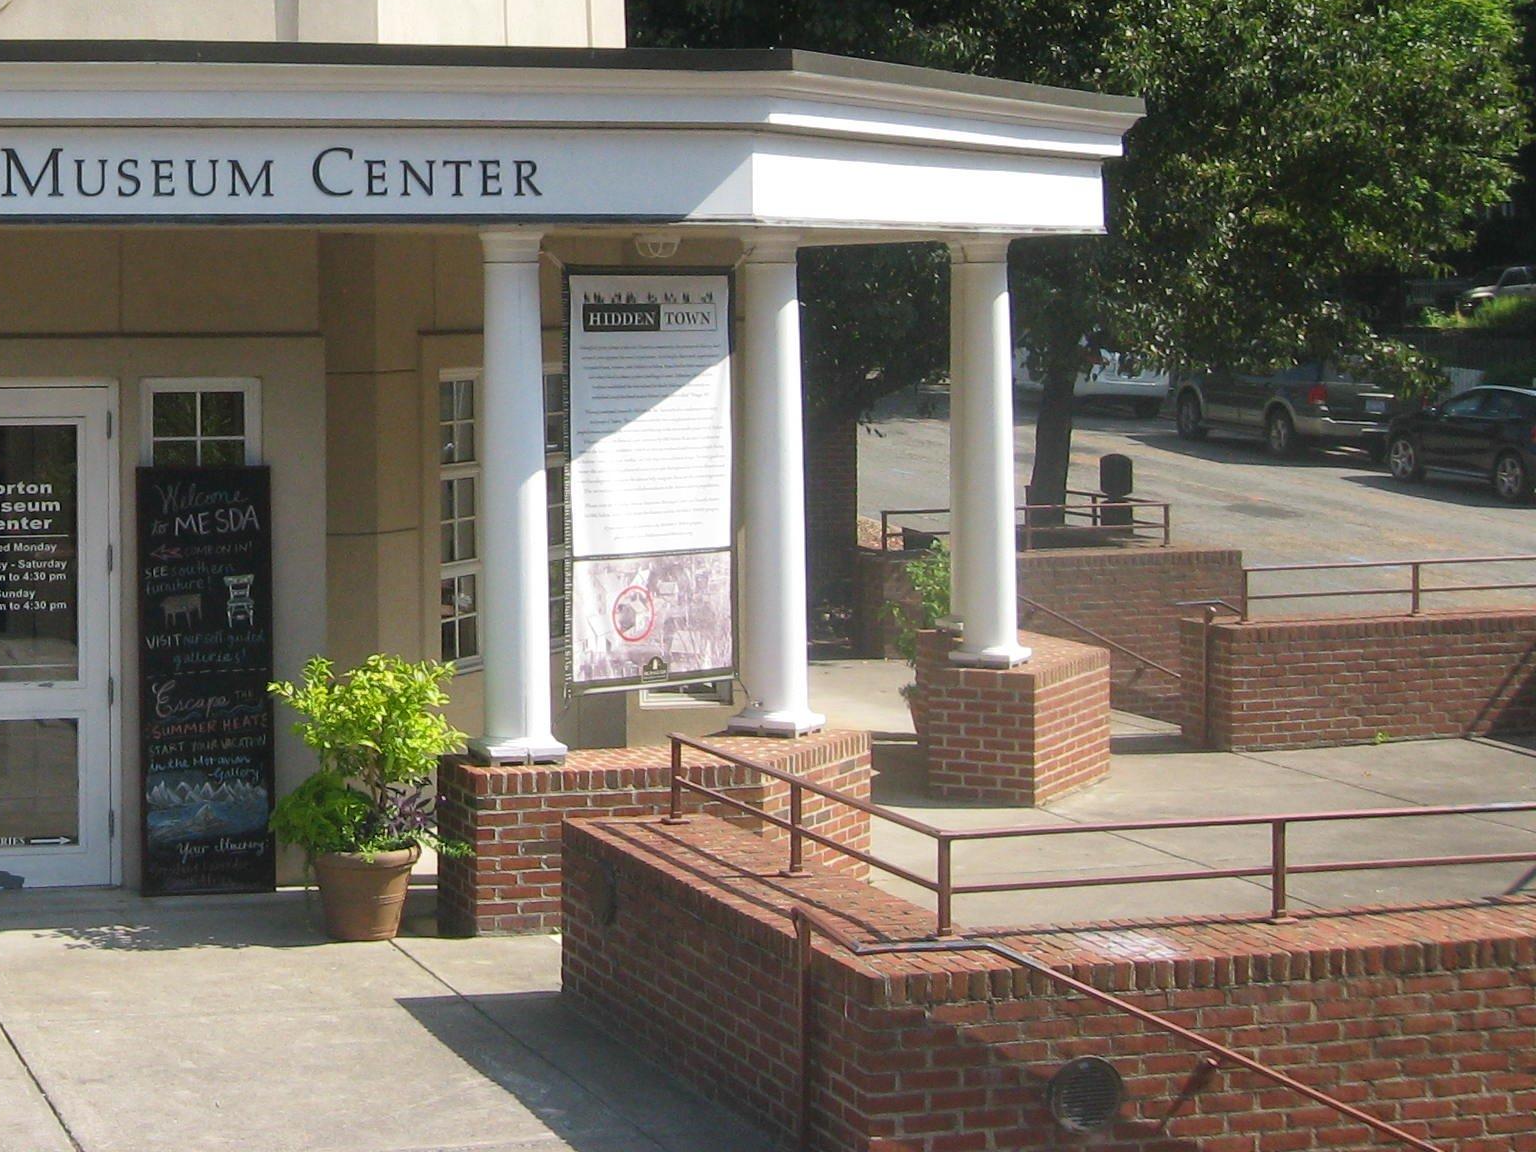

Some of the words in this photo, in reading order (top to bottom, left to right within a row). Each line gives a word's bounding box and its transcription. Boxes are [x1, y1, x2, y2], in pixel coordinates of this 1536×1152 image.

[0, 147, 276, 198] MUSEUM
[311, 147, 544, 198] CENTER
[588, 311, 657, 327] HIDDEN
[664, 310, 712, 326] TOWN
[13, 542, 58, 554] Monday
[17, 559, 68, 569] Saturday
[8, 572, 21, 582] to
[23, 571, 47, 582] 4:30
[48, 573, 67, 584] pm
[144, 565, 169, 580] SEE
[8, 602, 21, 611] to
[23, 601, 47, 611] 4:30
[49, 602, 68, 612] pm
[145, 633, 182, 649] VISIT
